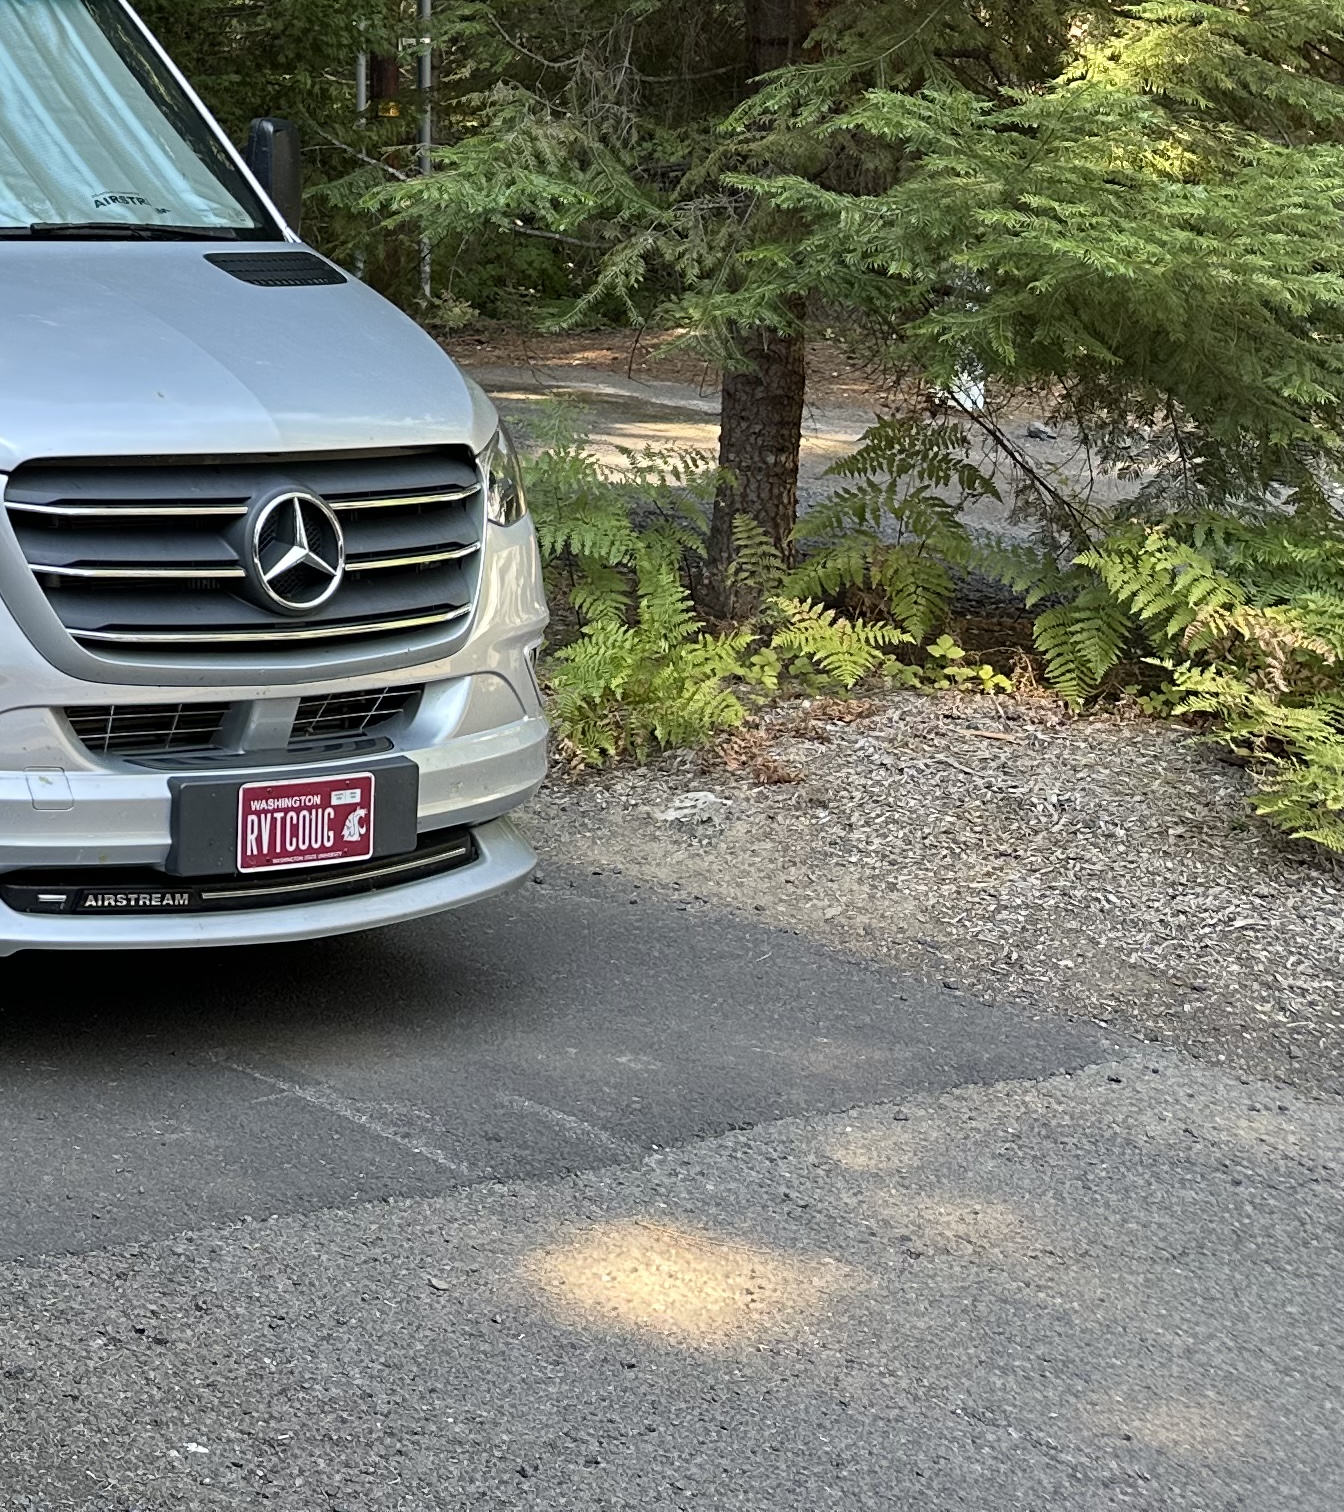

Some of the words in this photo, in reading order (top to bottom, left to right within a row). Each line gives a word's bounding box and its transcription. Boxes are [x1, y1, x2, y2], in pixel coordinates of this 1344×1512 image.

[250, 794, 322, 811] WASHINGTON
[246, 807, 335, 857] RVTCOUG
[84, 893, 189, 907] AIRSTREAM
